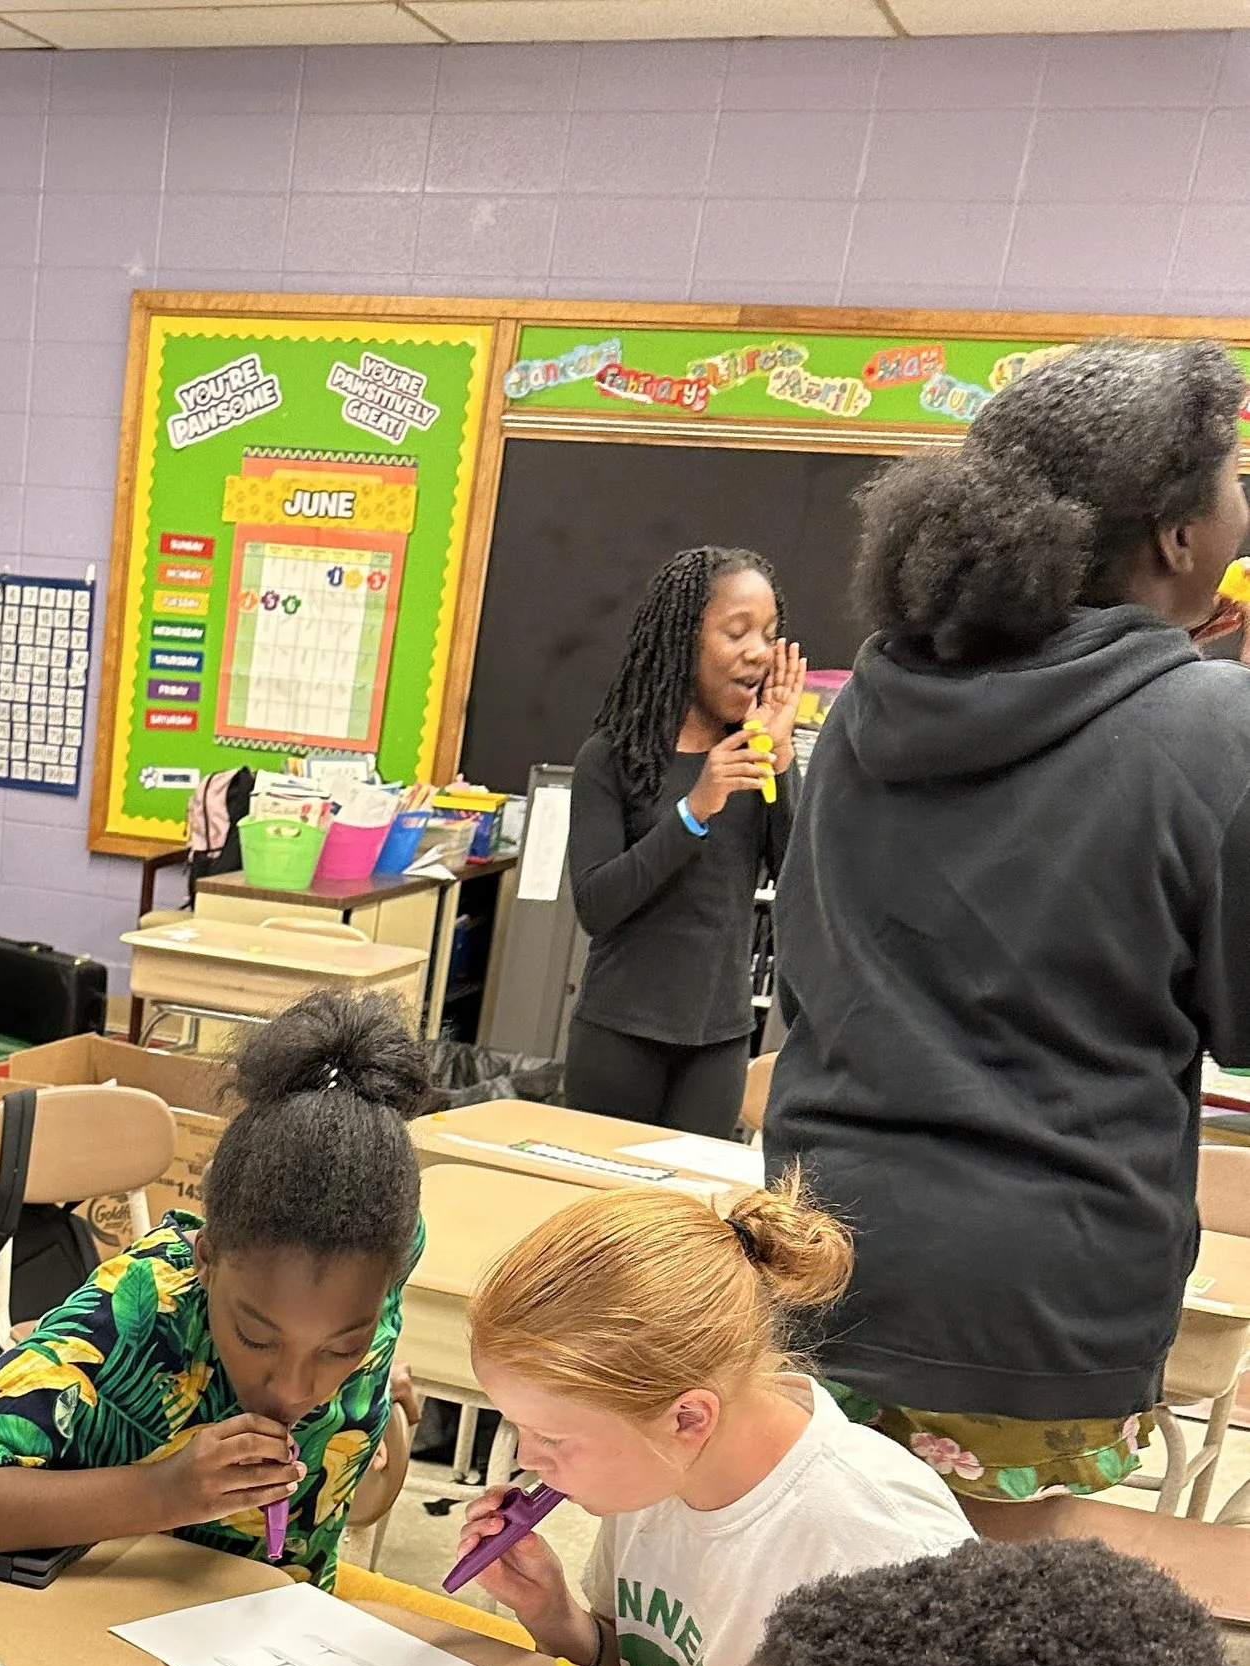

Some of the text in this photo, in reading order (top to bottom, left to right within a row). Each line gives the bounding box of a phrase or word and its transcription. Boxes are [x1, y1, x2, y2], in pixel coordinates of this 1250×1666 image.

[179, 358, 260, 412] YOU'RE
[331, 367, 436, 427] PAWSITIVELY
[362, 356, 424, 396] YOU'RE
[171, 379, 279, 443] PAWSOME
[345, 400, 406, 440] GREAT!
[284, 491, 356, 518] JUNE
